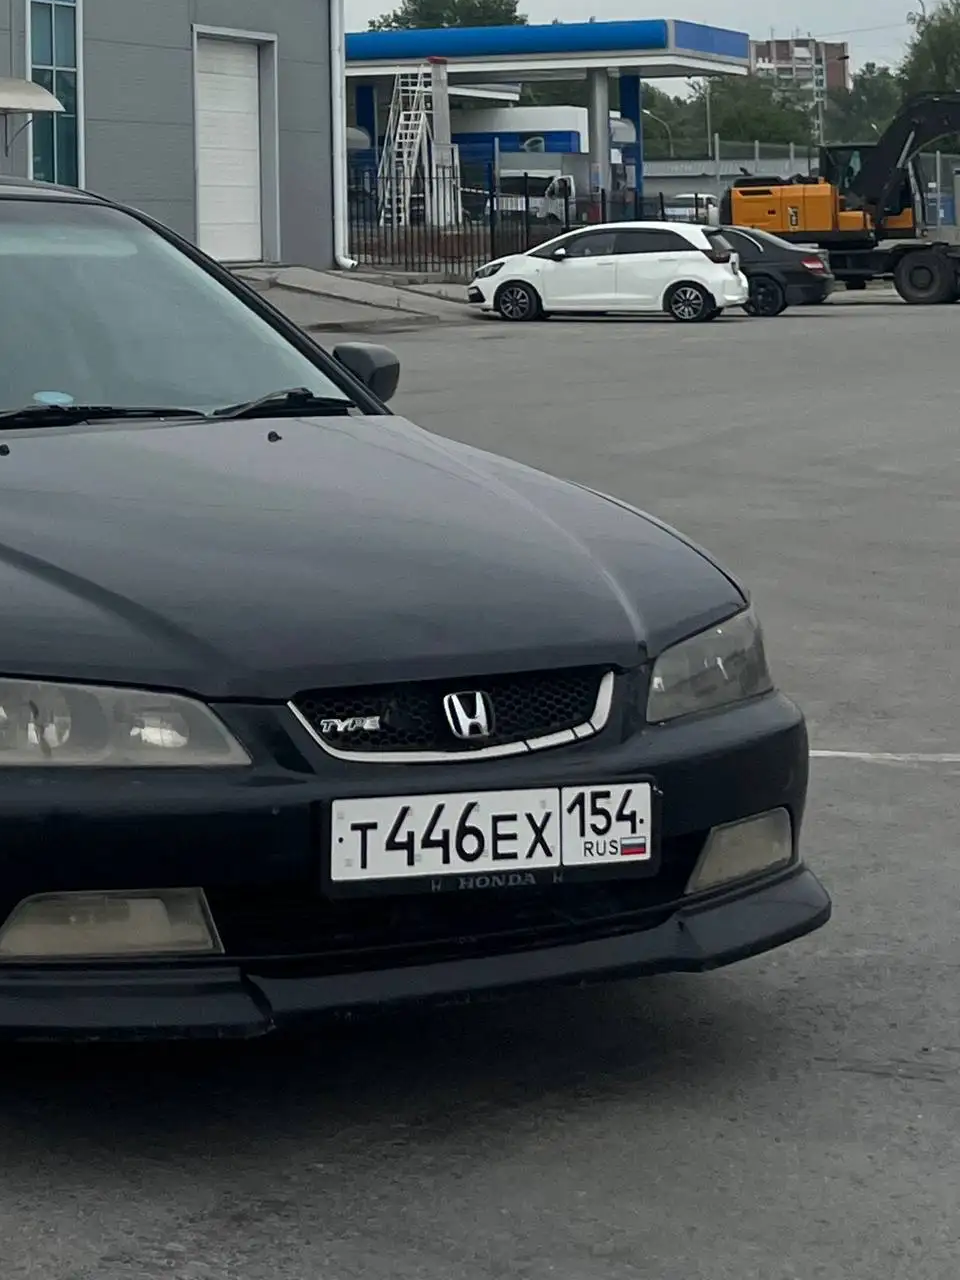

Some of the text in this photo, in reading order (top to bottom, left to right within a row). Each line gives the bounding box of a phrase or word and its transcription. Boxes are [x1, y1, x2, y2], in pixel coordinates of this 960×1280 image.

[567, 789, 637, 837] 154
[350, 801, 553, 869] T446EX
[583, 839, 619, 857] RUS
[459, 872, 536, 890] HONDA
